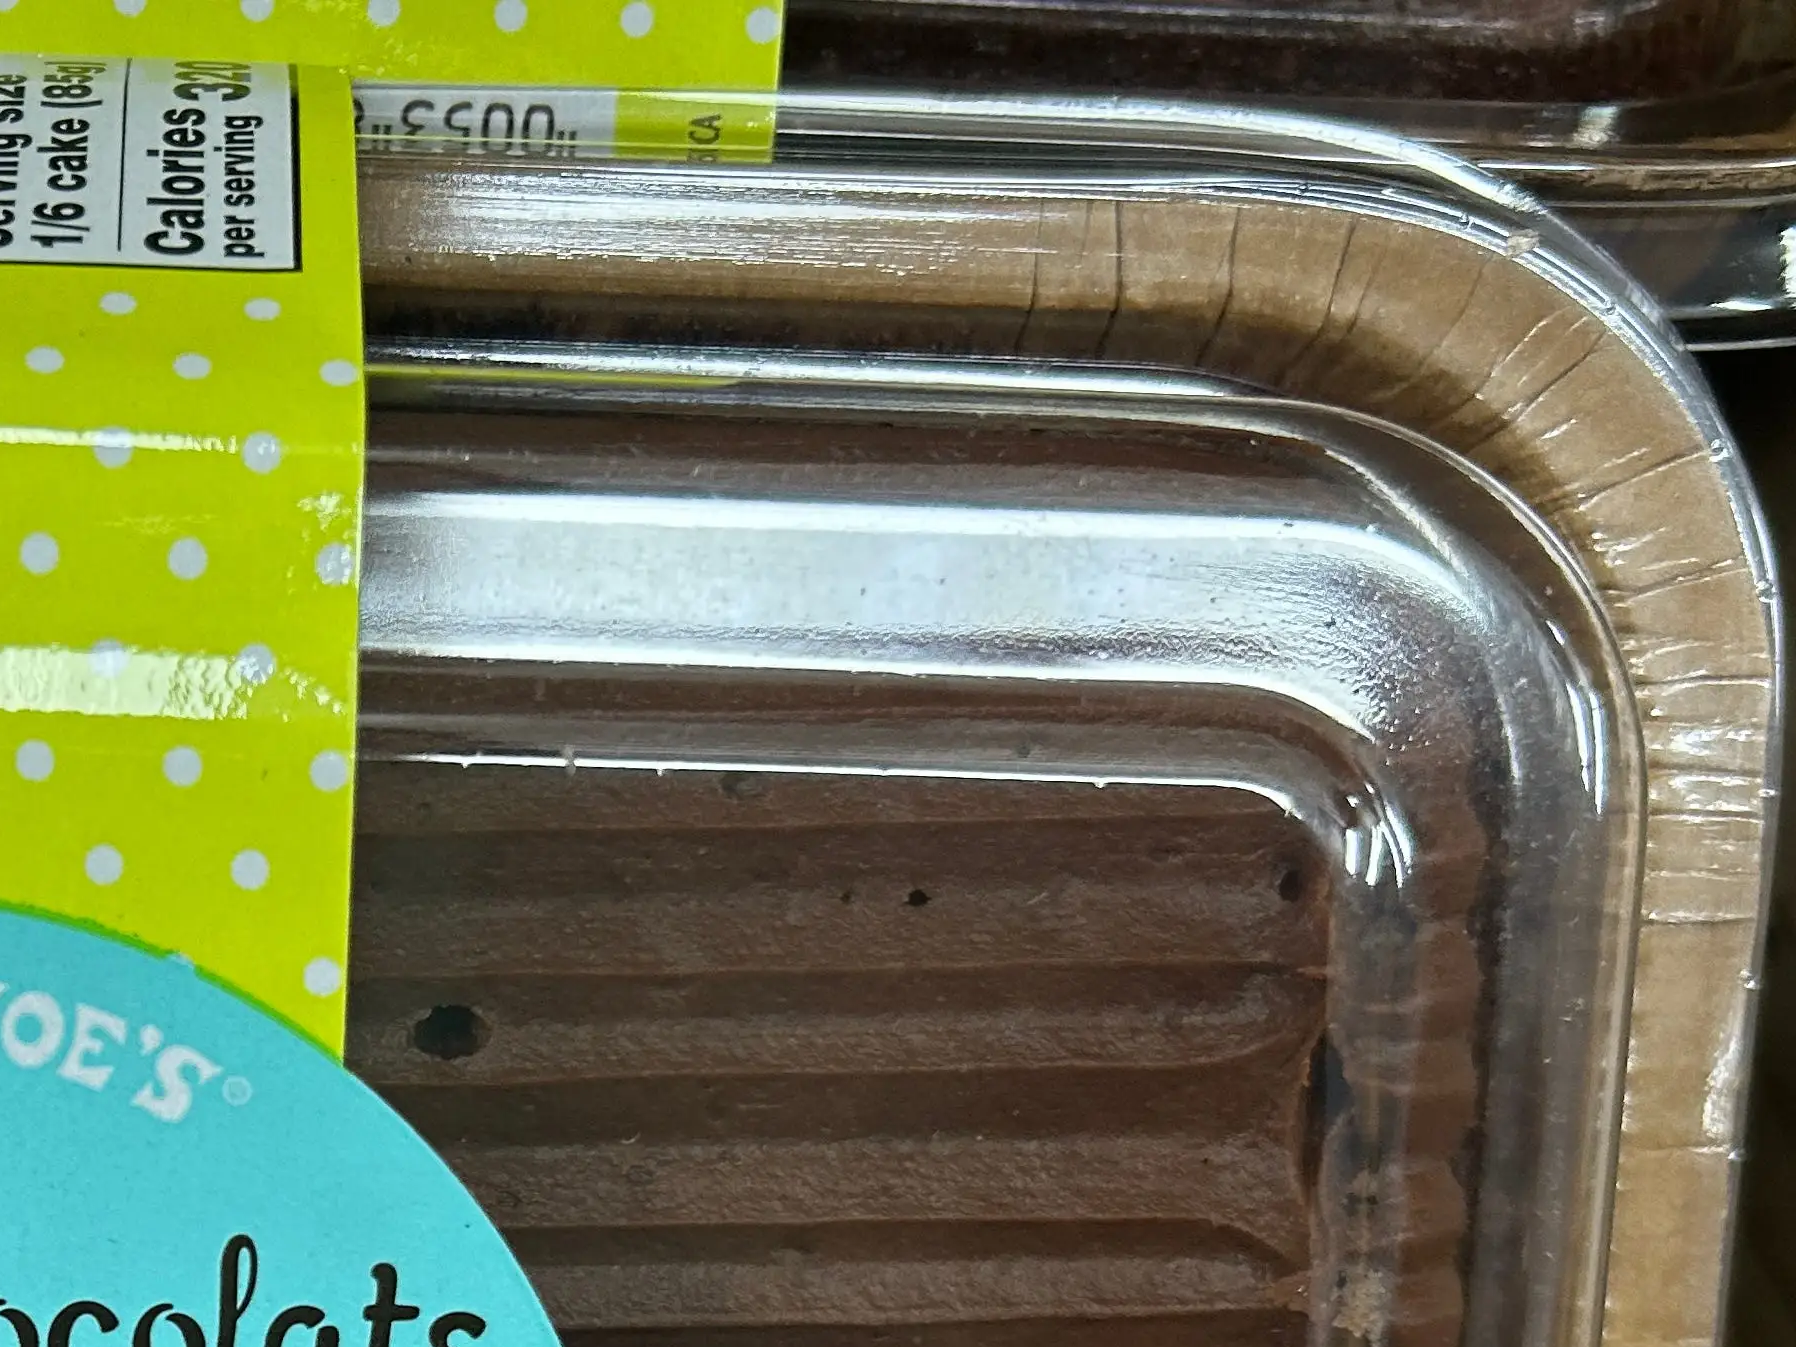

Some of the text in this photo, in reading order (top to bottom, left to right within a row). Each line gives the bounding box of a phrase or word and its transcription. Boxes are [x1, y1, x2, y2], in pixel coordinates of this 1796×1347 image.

[36, 118, 90, 191] cake
[144, 60, 251, 256] Calories 320
[213, 115, 265, 258] per serving
[30, 202, 90, 248] 1/6
